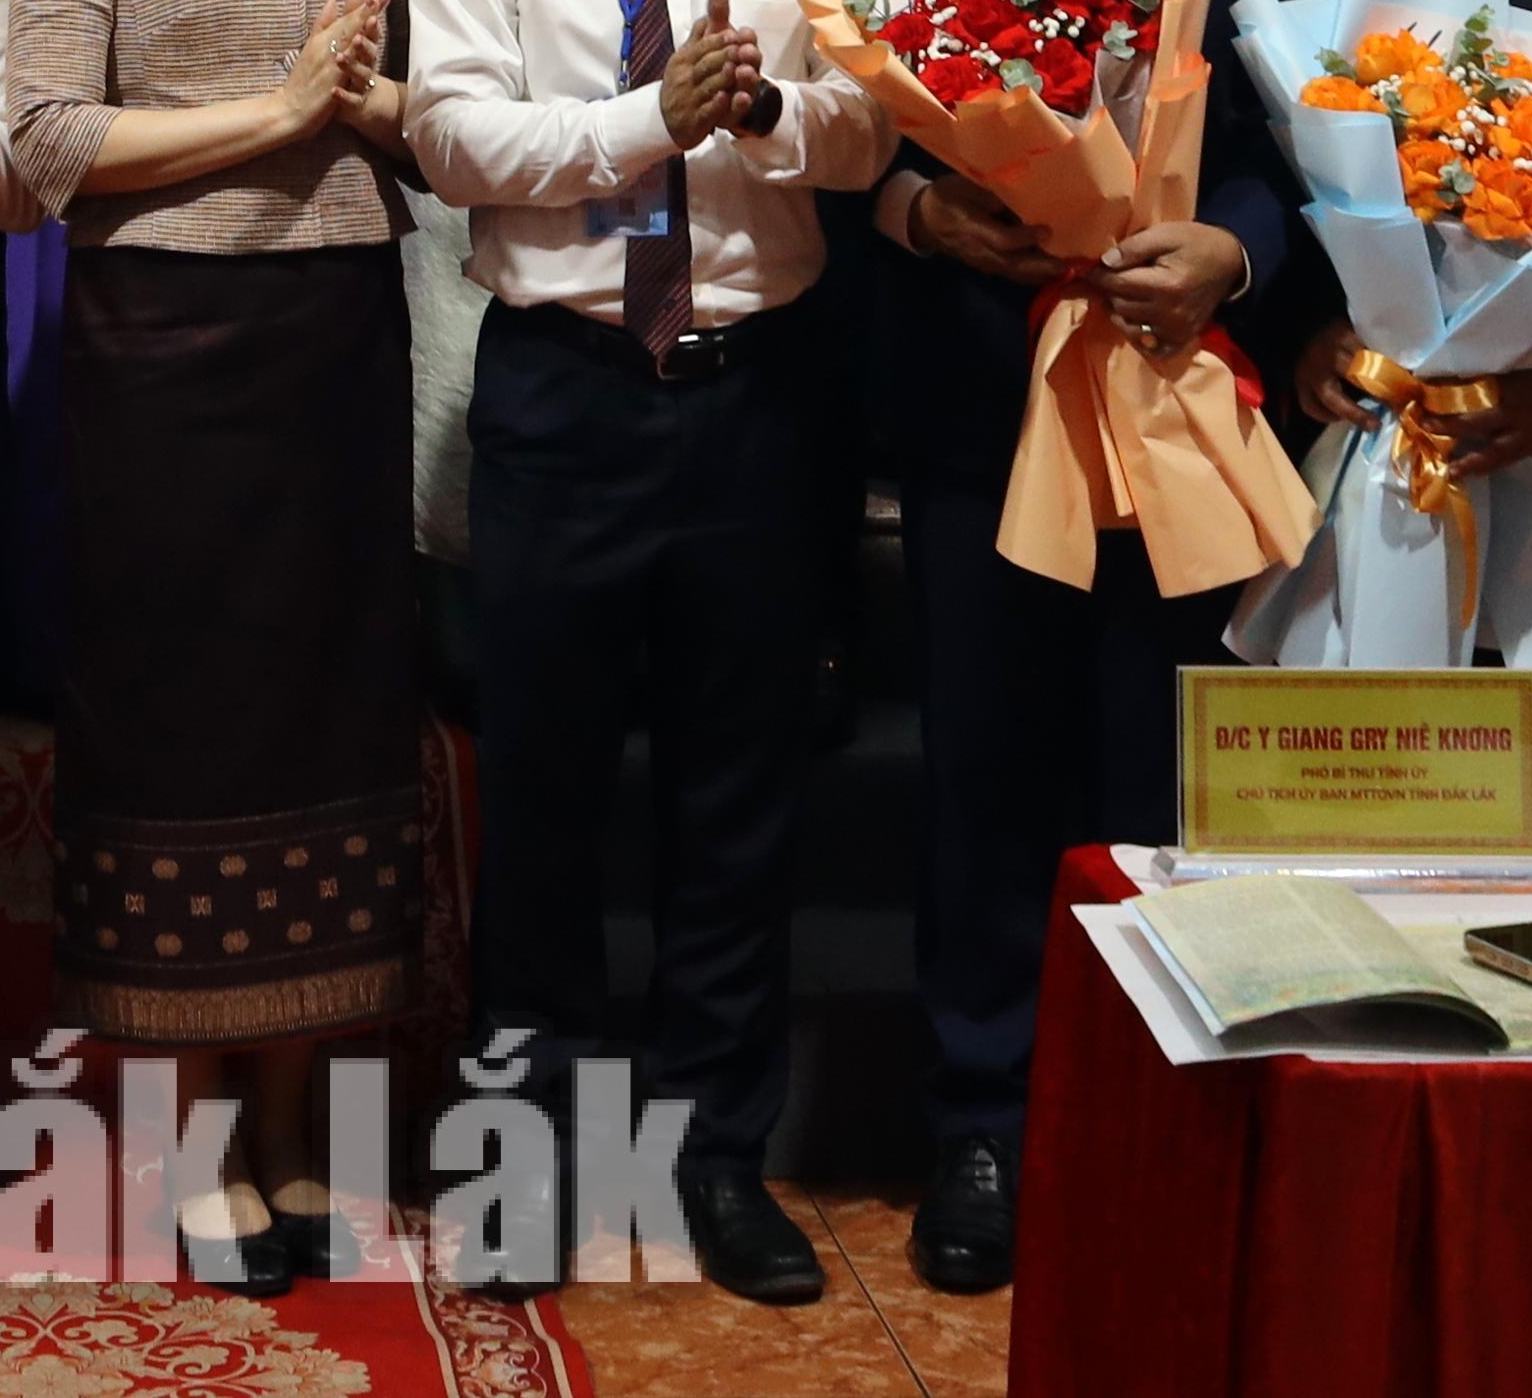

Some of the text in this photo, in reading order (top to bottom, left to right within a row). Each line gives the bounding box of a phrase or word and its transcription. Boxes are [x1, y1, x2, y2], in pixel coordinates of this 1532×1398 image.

[1215, 725, 1250, 752] Đ/C
[1258, 726, 1270, 751] Y
[1277, 726, 1343, 752] GIANG
[1350, 726, 1390, 752] GRY
